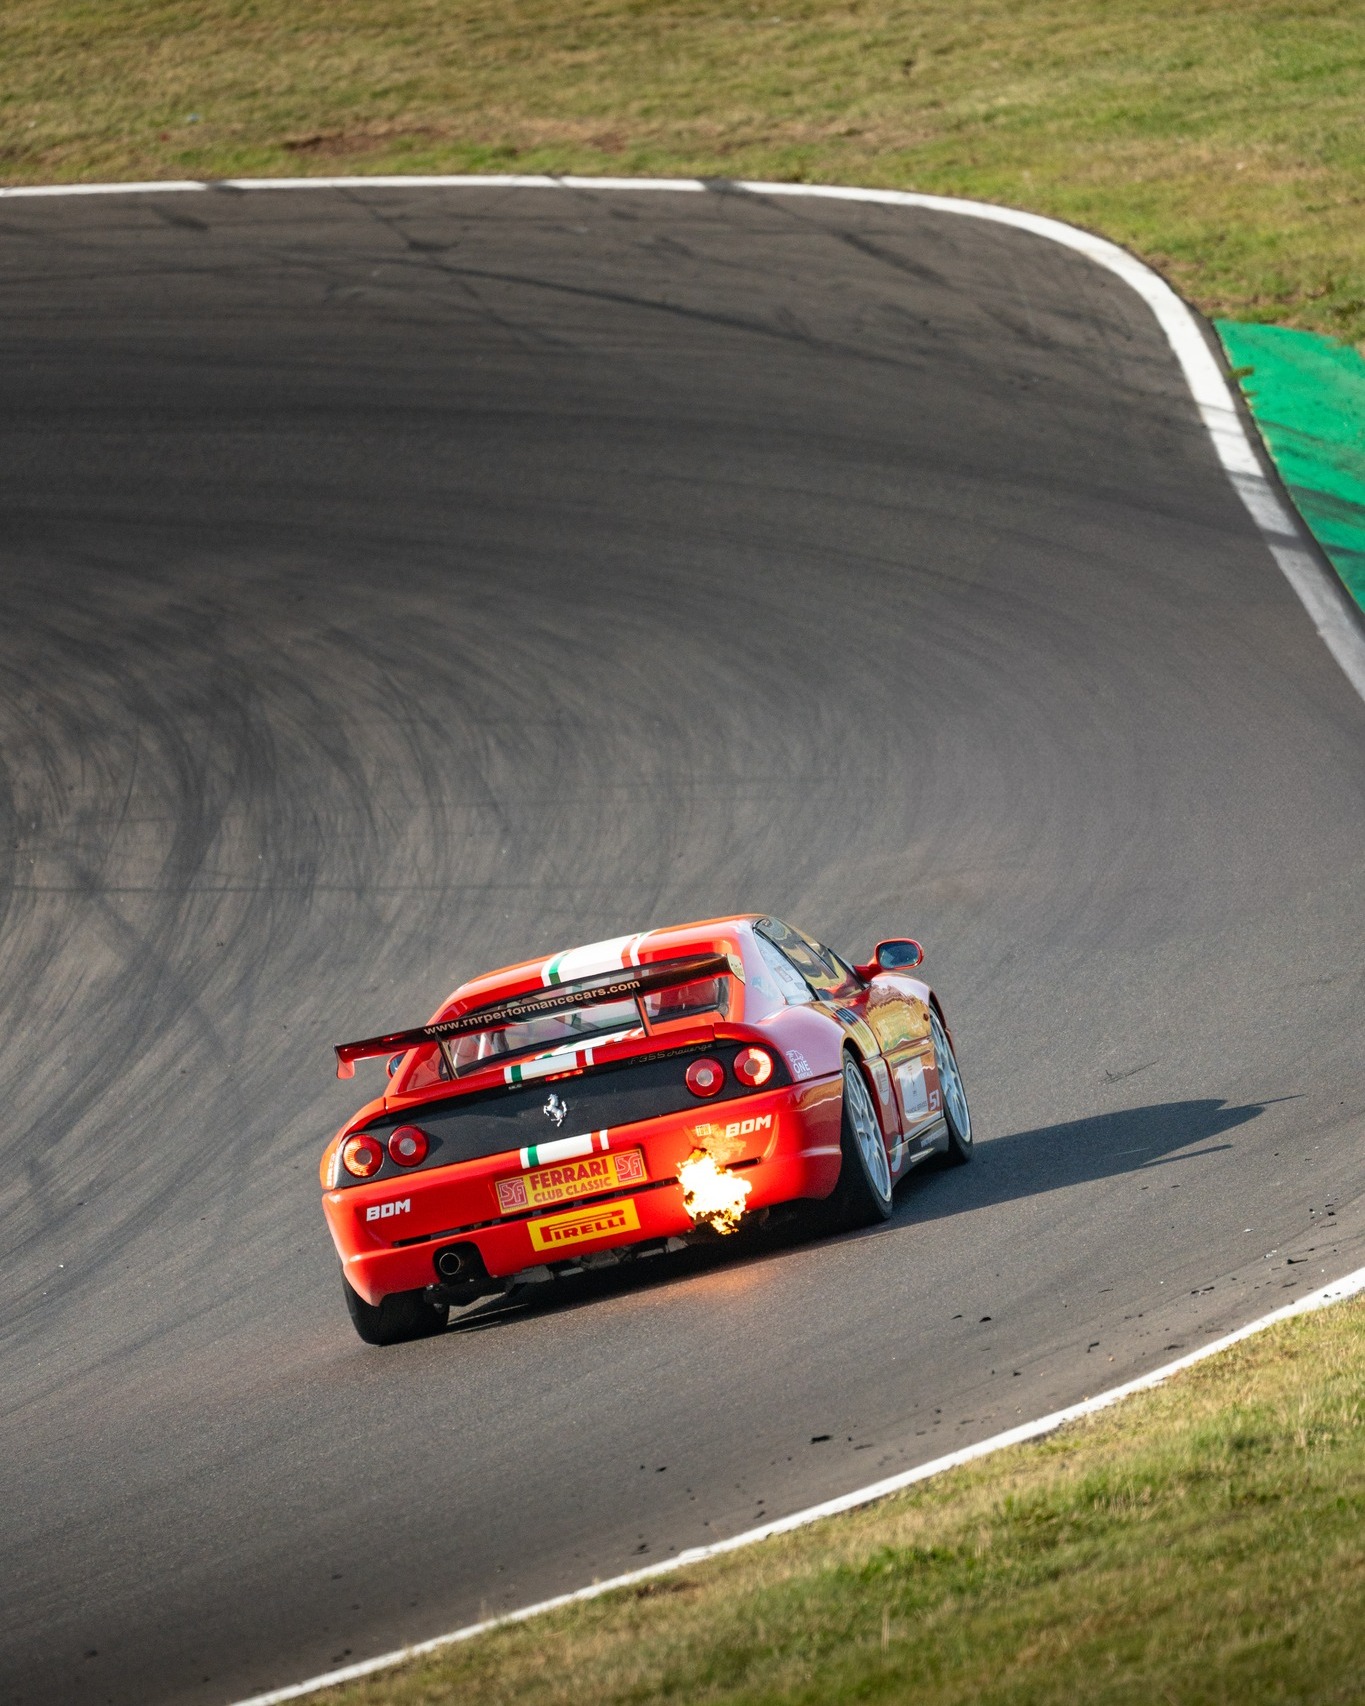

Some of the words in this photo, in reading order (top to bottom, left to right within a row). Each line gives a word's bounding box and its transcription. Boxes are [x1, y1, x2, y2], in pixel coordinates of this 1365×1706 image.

[424, 980, 641, 1035] www.rnrperformancecars.com
[793, 1060, 811, 1073] ONE
[725, 1114, 772, 1138] BDM
[529, 1159, 609, 1190] FERRARI
[533, 1190, 563, 1203] CLUB
[565, 1177, 613, 1196] CLASSIC
[366, 1198, 411, 1222] BDM
[539, 1209, 627, 1243] PIRELLI
